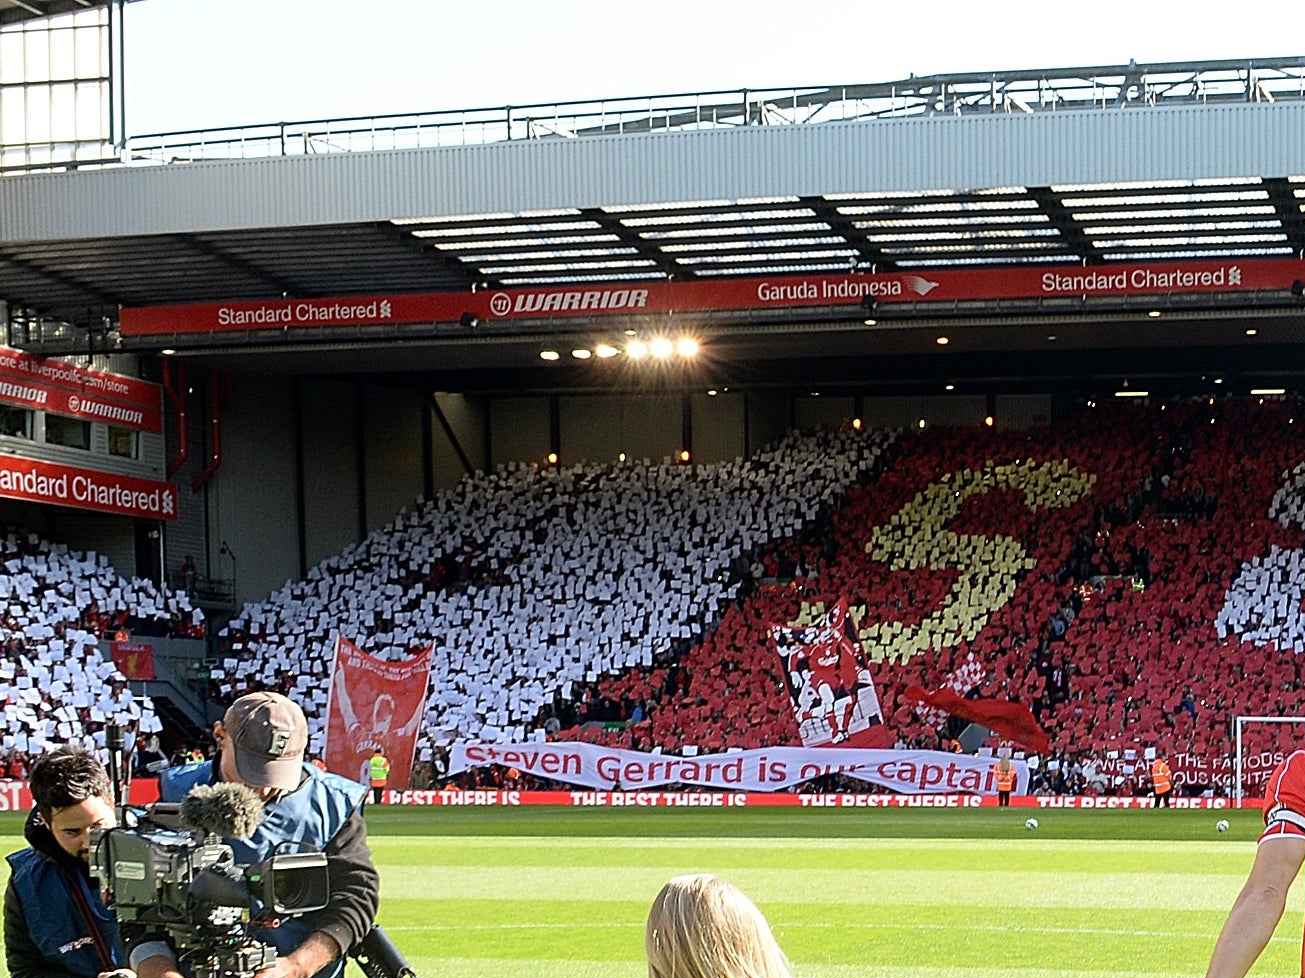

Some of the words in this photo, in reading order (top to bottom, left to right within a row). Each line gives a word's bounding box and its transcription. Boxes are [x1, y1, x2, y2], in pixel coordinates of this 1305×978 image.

[757, 281, 818, 301] Garuda
[821, 278, 902, 298] Indonesia
[1041, 271, 1128, 293] Standard
[1129, 267, 1225, 288] Chartered
[513, 289, 649, 312] WARRIOR
[218, 305, 292, 325] Standard
[296, 301, 378, 321] Chartered
[80, 400, 143, 423] WARRIOR
[0, 468, 67, 498] andard
[72, 476, 159, 512] Chartered
[465, 746, 582, 775] Steven
[597, 756, 743, 784] Gerrard
[757, 757, 787, 782] is
[877, 761, 1018, 793] captai
[1174, 752, 1208, 769] THE
[0, 781, 23, 811] ST
